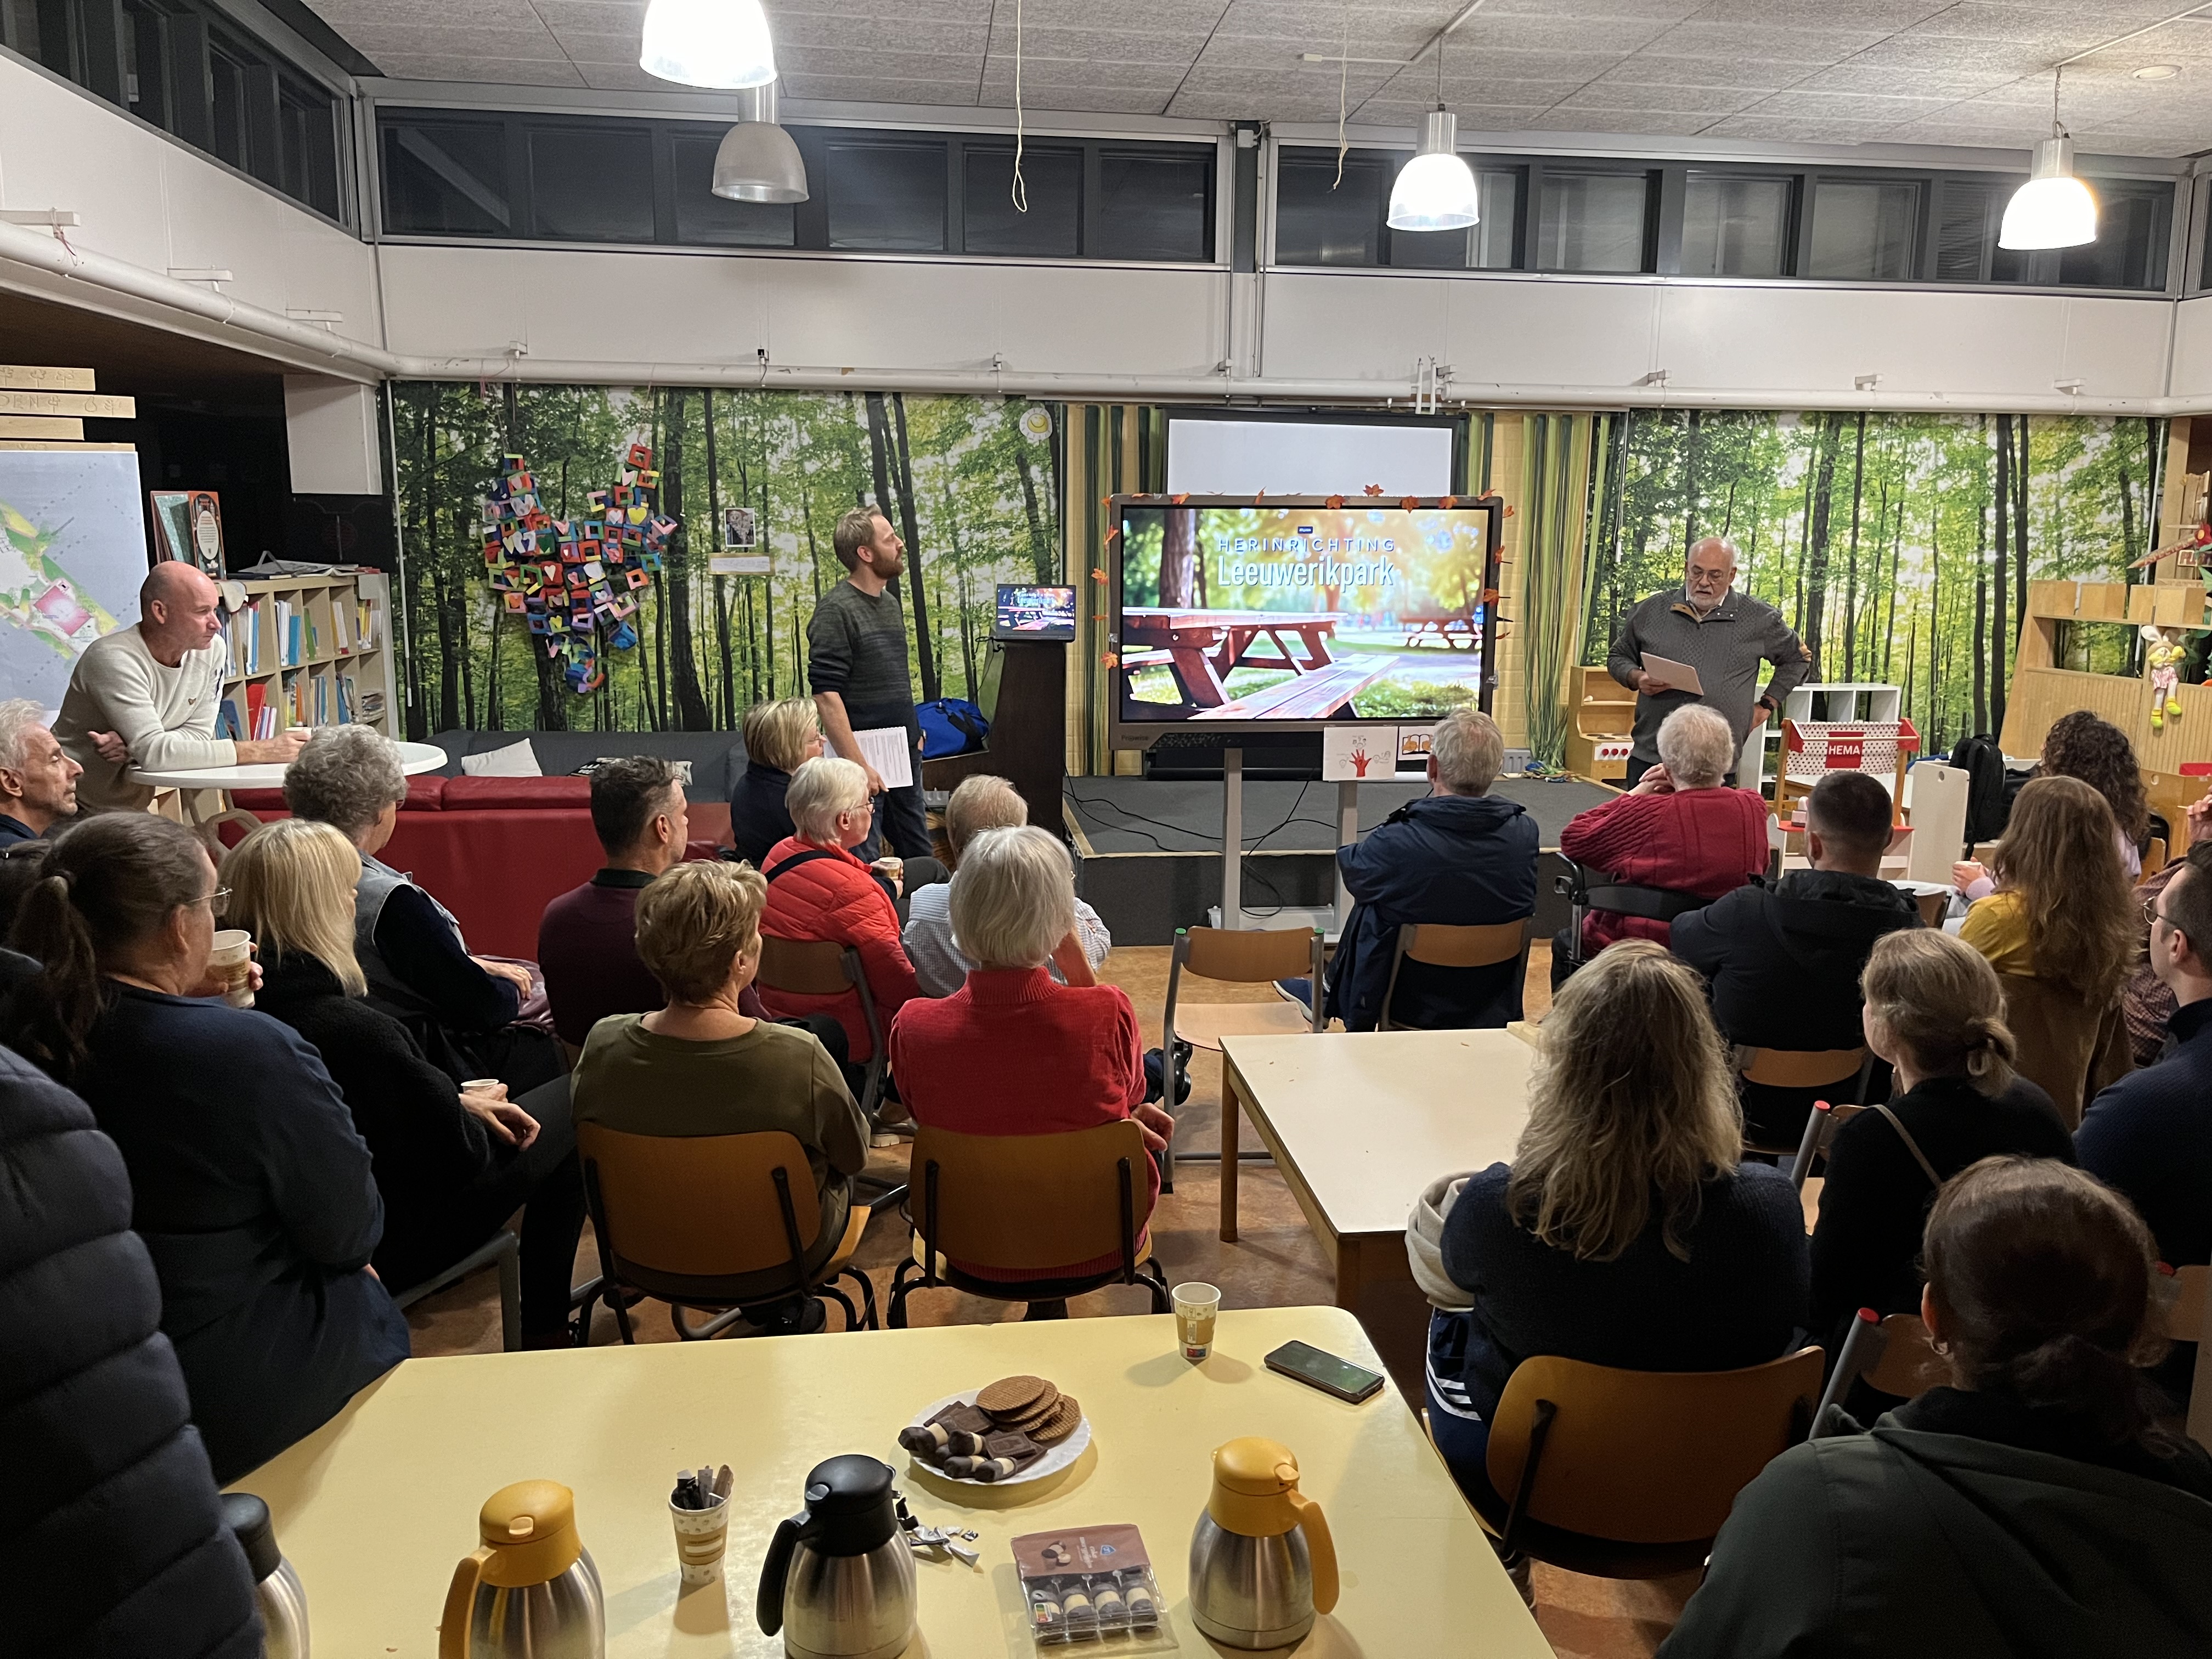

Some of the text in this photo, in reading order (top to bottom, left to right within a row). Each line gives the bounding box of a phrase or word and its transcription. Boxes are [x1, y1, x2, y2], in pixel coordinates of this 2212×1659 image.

[1218, 538, 1394, 552] HERINRICHTING
[1218, 555, 1393, 593] Leeuwerikpark
[1829, 745, 1860, 755] HEMA
